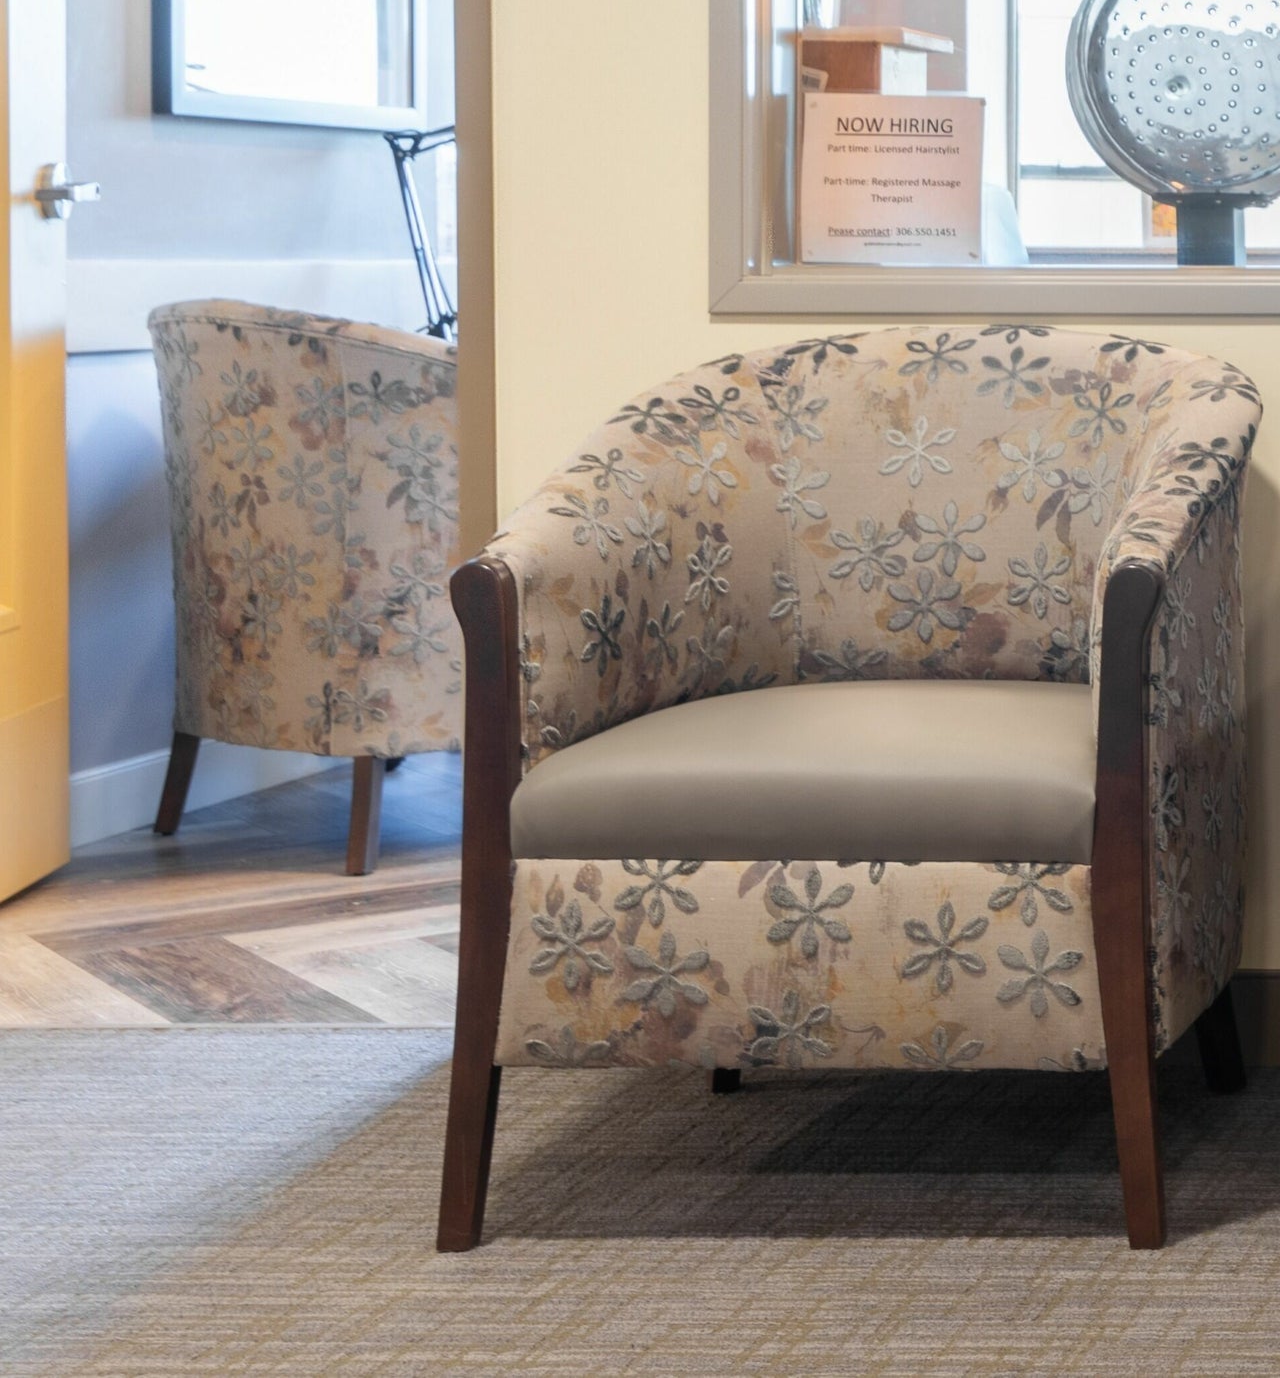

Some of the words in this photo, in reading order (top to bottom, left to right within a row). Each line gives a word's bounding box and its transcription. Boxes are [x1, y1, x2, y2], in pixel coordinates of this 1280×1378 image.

[837, 117, 884, 133] NOW
[890, 118, 954, 134] HIRING
[828, 144, 846, 153] Part
[874, 145, 913, 154] Licensed
[915, 145, 960, 156] Hairstylist
[871, 177, 920, 189] Registered
[922, 178, 961, 189] Massage
[871, 194, 914, 204] Therapist
[895, 228, 957, 237] 306.550.1451
